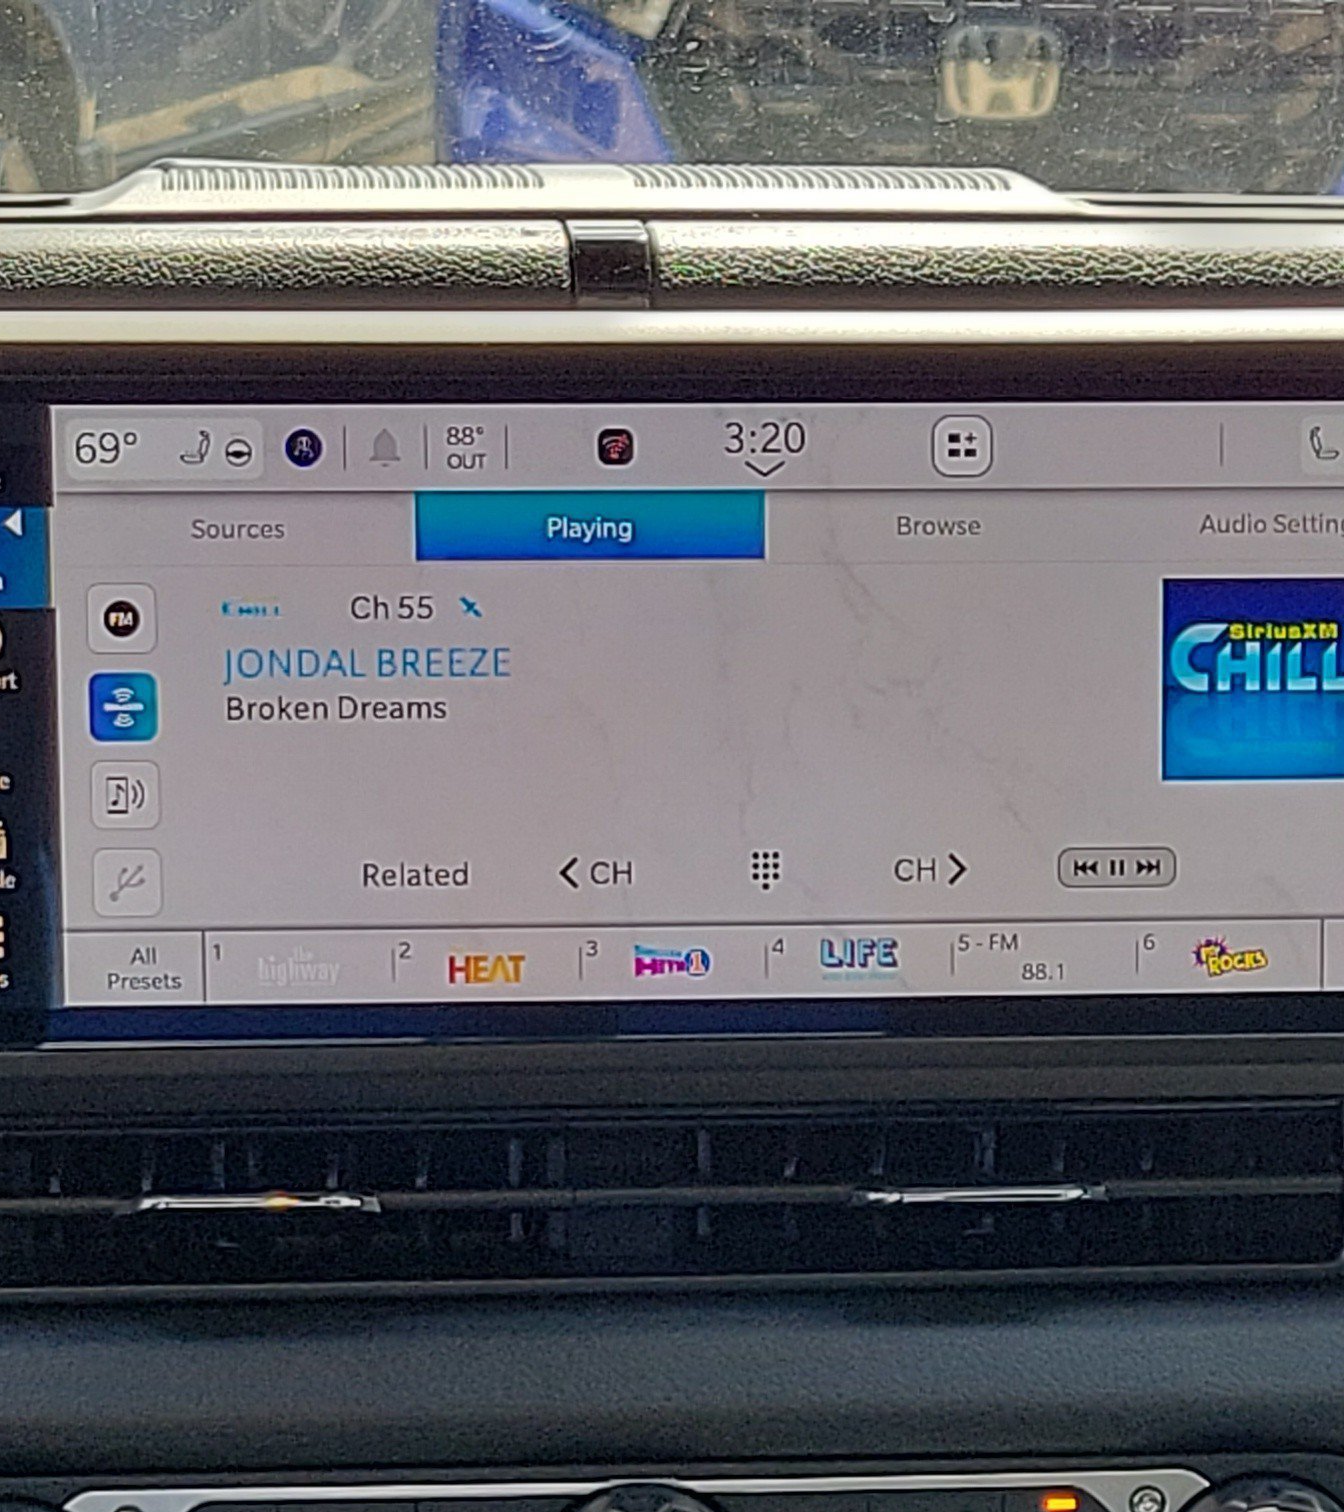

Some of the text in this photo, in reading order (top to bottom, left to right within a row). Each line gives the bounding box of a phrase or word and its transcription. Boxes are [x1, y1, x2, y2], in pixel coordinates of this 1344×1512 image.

[446, 426, 484, 446] 88°
[724, 421, 806, 454] 3:20
[74, 431, 138, 464] 69°
[447, 454, 487, 471] OUT
[190, 519, 285, 540] Sources
[547, 517, 634, 543] Playing
[896, 515, 982, 537] Browse
[1199, 513, 1267, 535] Audio
[350, 595, 434, 620] Ch 55
[1228, 622, 1339, 640] SiriusXM
[223, 648, 512, 686] JONDAL BREEZE
[227, 695, 447, 722] Broken Dreams
[362, 862, 470, 888] Related
[590, 861, 633, 885] CH
[894, 858, 937, 882] CH
[213, 943, 221, 960] 1
[398, 942, 411, 959] 2
[586, 940, 598, 957] 3
[771, 939, 785, 955] 4
[958, 934, 970, 951] 5
[989, 933, 1019, 950] FM
[1143, 933, 1155, 950] 6
[130, 947, 157, 965] All
[821, 937, 899, 968] LIFE
[448, 954, 526, 985] HEAT
[1021, 962, 1065, 981] 88.1
[107, 973, 183, 991] Presets
